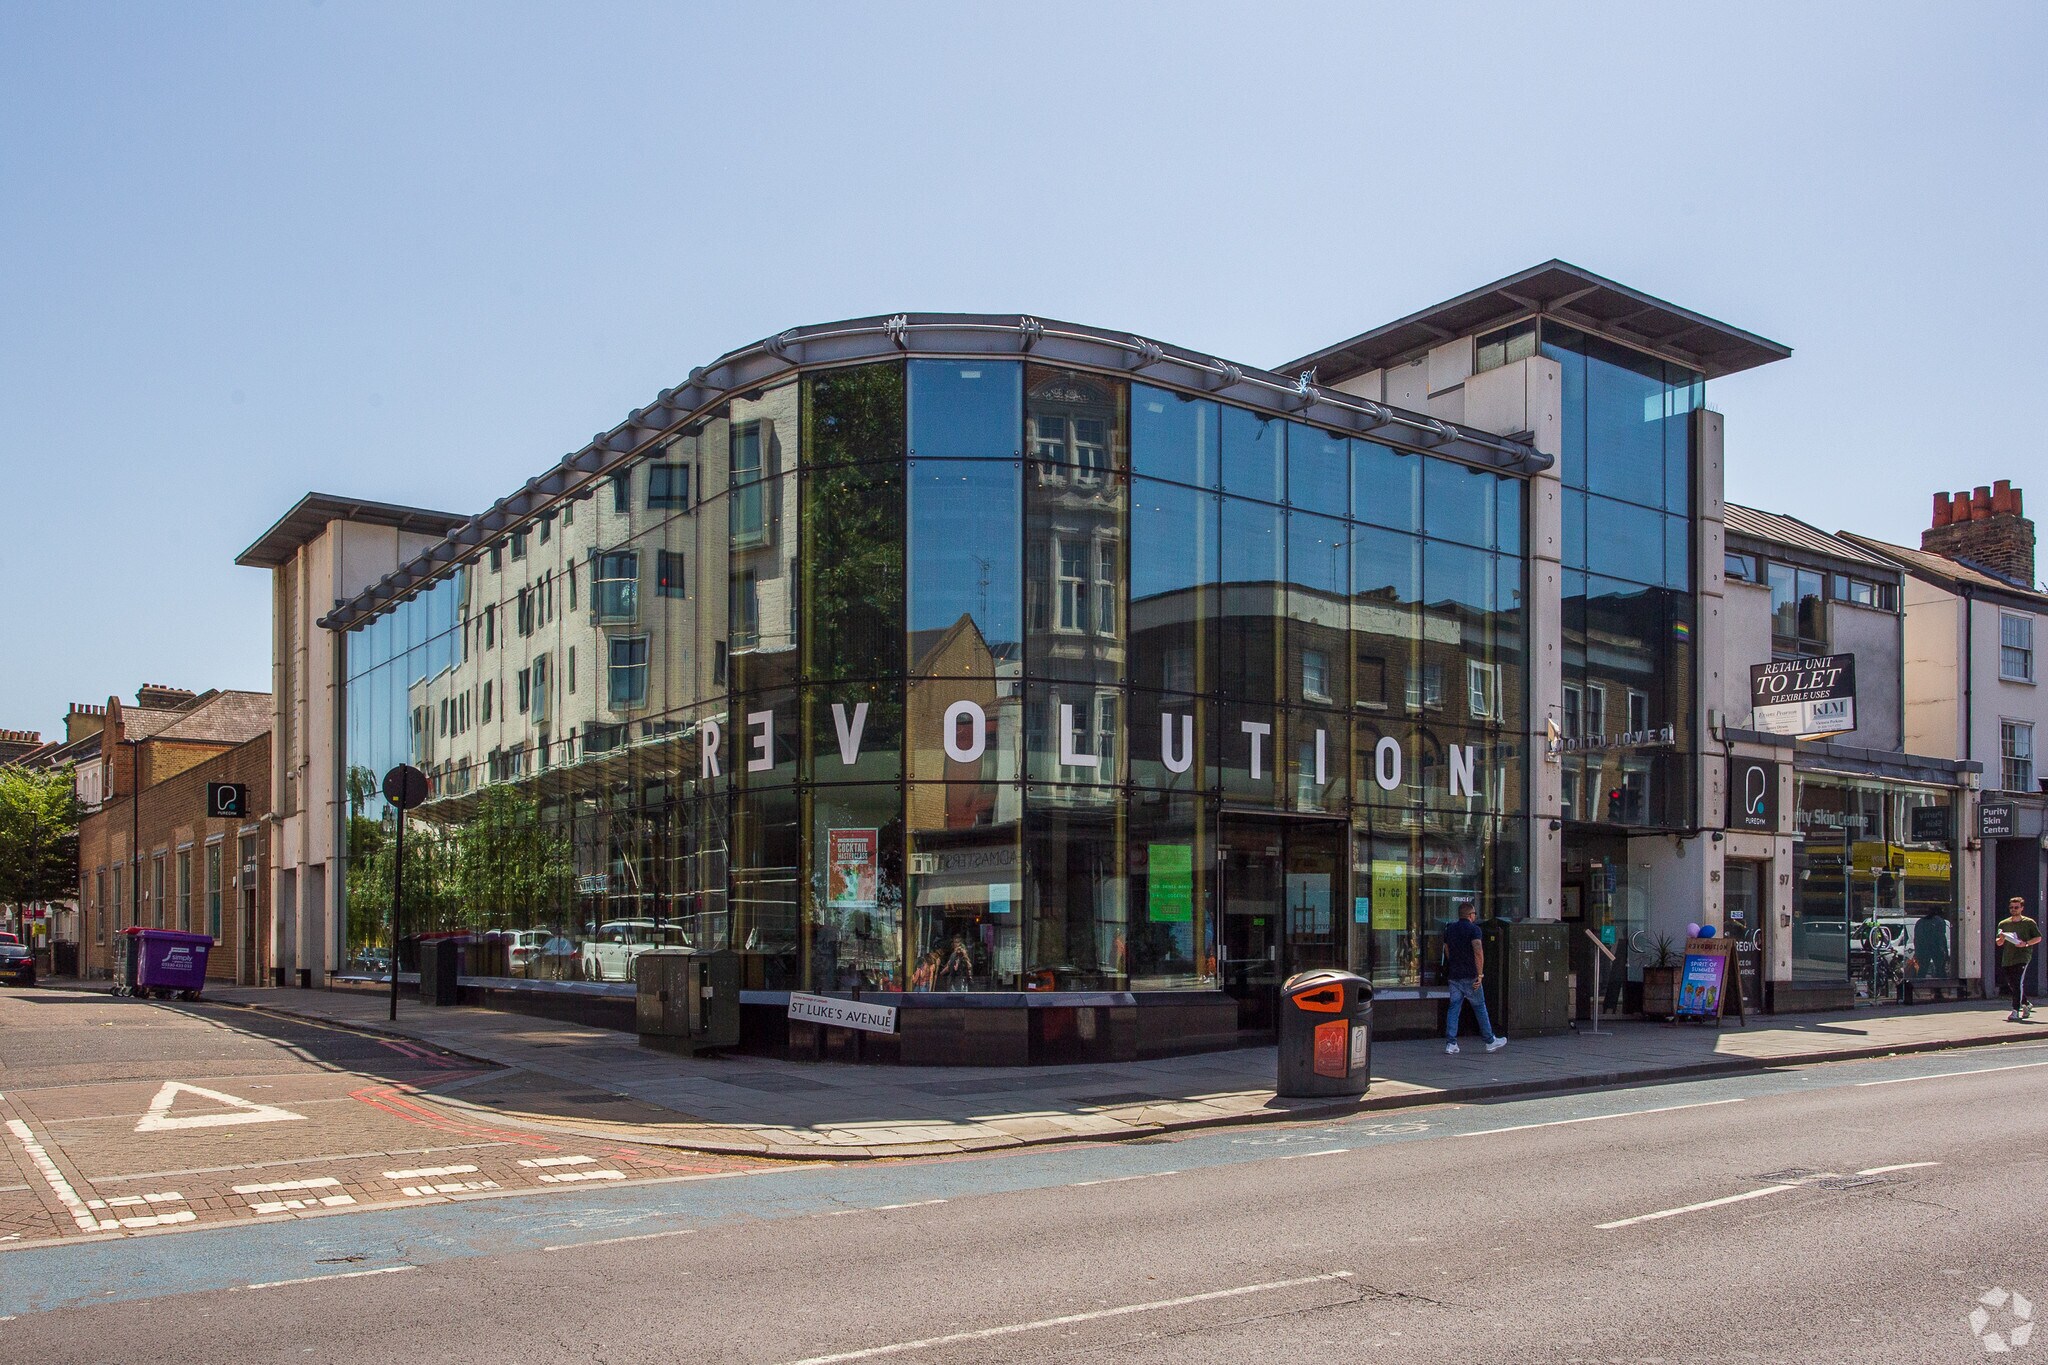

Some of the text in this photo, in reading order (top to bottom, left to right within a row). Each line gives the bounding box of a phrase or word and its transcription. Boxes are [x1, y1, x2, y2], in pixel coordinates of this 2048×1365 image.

[1764, 657, 1833, 674] RETAIL UNIT
[1756, 668, 1842, 695] TO LET
[1770, 690, 1831, 704] FLEXIBLE USES
[1814, 808, 1836, 825] Skin
[1838, 811, 1869, 828] Centre
[1983, 808, 2008, 817] Purity
[1745, 817, 1766, 825] PUREGYM
[1983, 817, 2001, 825] Skin
[1983, 826, 2010, 834] Centre
[837, 842, 868, 853] COCKTAIL
[1710, 870, 1720, 883] 95
[1780, 874, 1790, 886] 97
[791, 1002, 891, 1027] ST LUKE'S AVENUE
